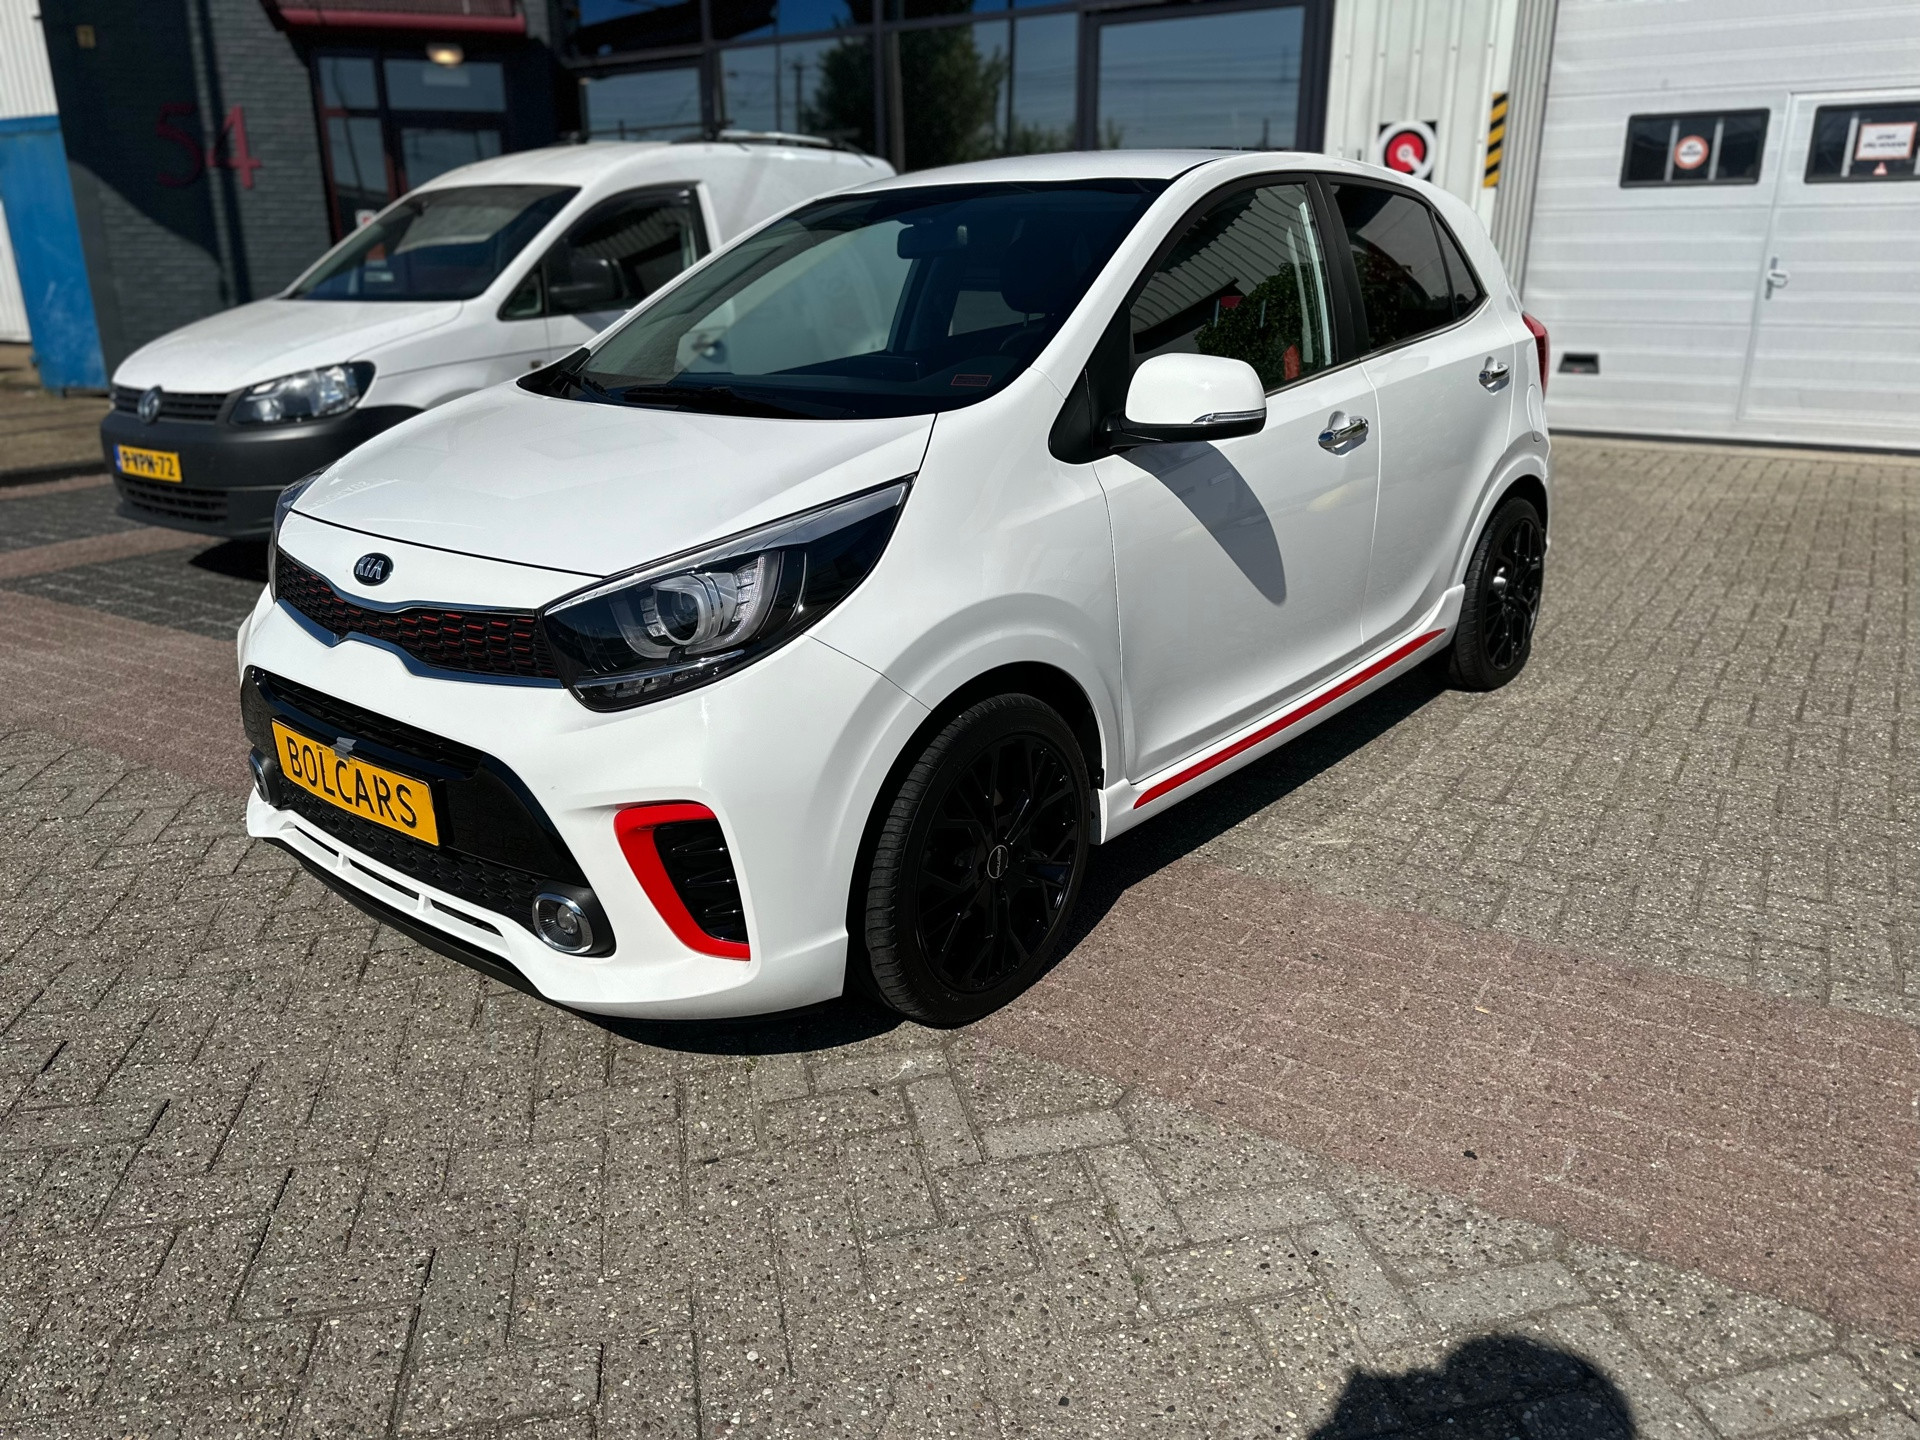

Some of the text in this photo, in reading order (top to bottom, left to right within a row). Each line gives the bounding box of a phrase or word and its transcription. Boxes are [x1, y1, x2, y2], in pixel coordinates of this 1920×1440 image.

[155, 100, 261, 189] 54
[356, 556, 384, 580] KIA
[286, 735, 418, 829] BOLCARS
